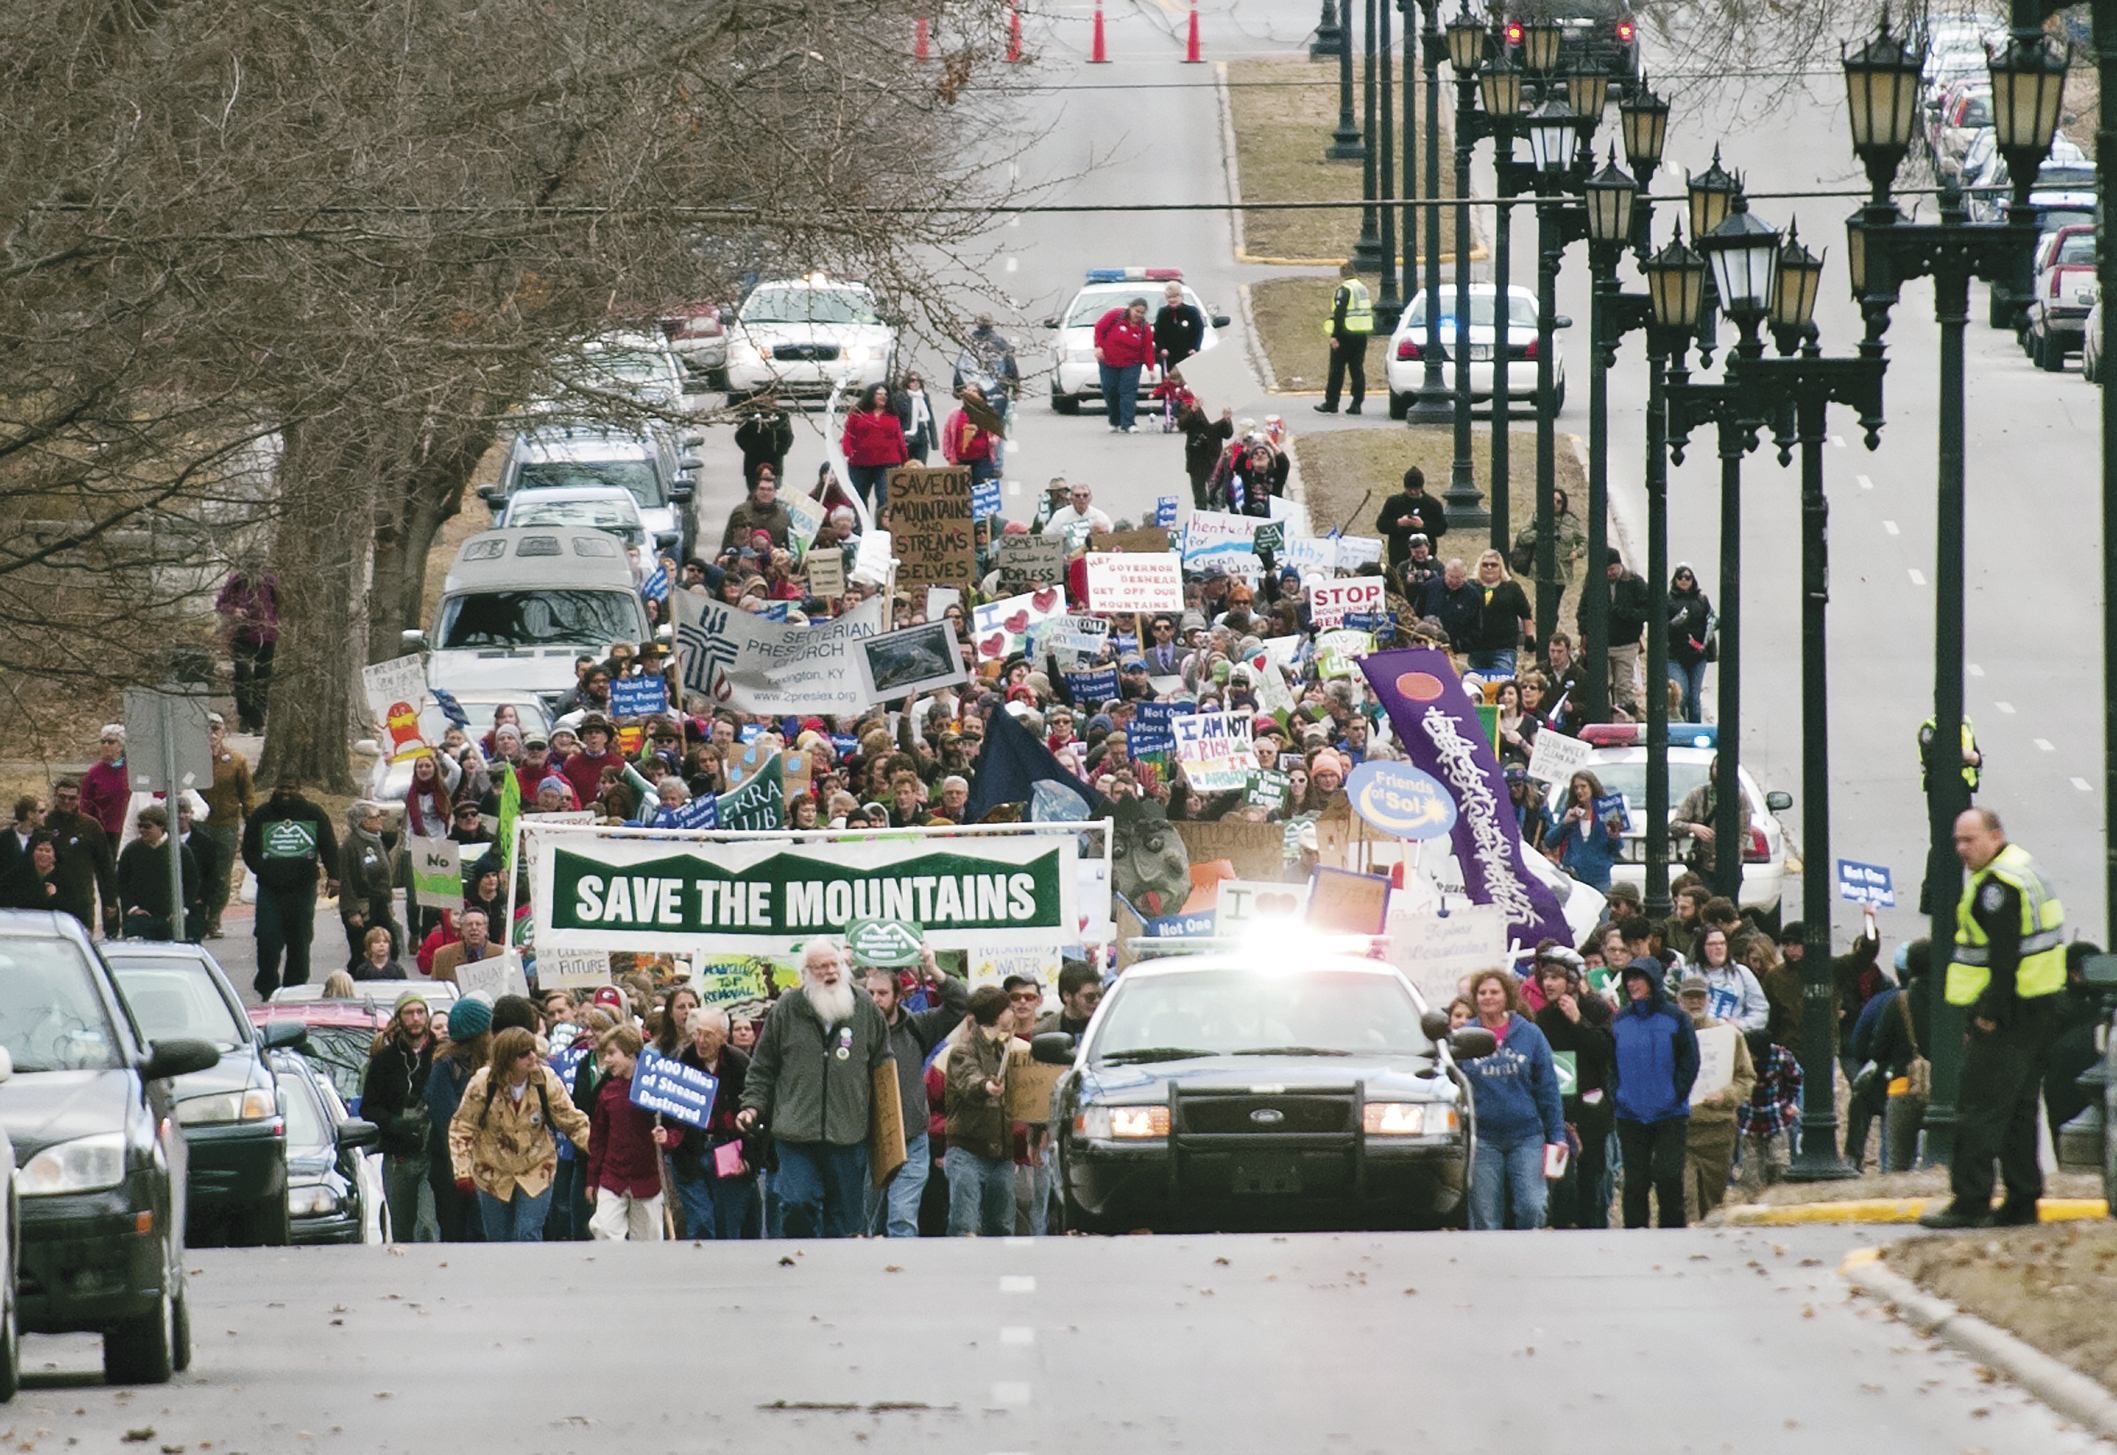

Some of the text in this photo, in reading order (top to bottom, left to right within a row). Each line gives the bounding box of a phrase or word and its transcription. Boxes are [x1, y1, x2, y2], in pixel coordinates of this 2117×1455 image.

[891, 472, 972, 498] SAVE OUR
[889, 499, 973, 522] MOUNTAINS
[919, 521, 944, 532] AND
[1191, 512, 1255, 536] Kentuck
[896, 532, 968, 554] STREAMS
[921, 551, 944, 562] AND
[1088, 556, 1111, 568] HEY
[897, 561, 968, 579] SELVES
[998, 566, 1055, 582] TOPLESS
[1108, 564, 1173, 572] GOVERNOR
[1120, 575, 1177, 584] BESHEAR
[1092, 587, 1176, 596] GET OFF OUR
[1314, 585, 1380, 606] STOP
[976, 603, 999, 632] I
[1078, 620, 1107, 633] COAL
[828, 670, 845, 679] KY
[1144, 707, 1164, 718] Not
[1179, 715, 1248, 741] I AM NOT
[1182, 739, 1229, 762] A RICH
[1258, 778, 1281, 796] New
[1376, 770, 1435, 795] Friends
[1371, 788, 1421, 814] of Sol
[426, 855, 450, 868] No
[576, 872, 1036, 927] SAVE THE MOUNTAINS
[1226, 888, 1251, 919] I
[1158, 918, 1211, 937] Not One
[558, 959, 608, 975] FUTURE
[994, 957, 1042, 976] WATER
[703, 986, 755, 1005] REMOVAL
[644, 1054, 714, 1090] 1,400 Miles
[640, 1074, 707, 1106] of Streams
[638, 1089, 701, 1123] Destroyed
